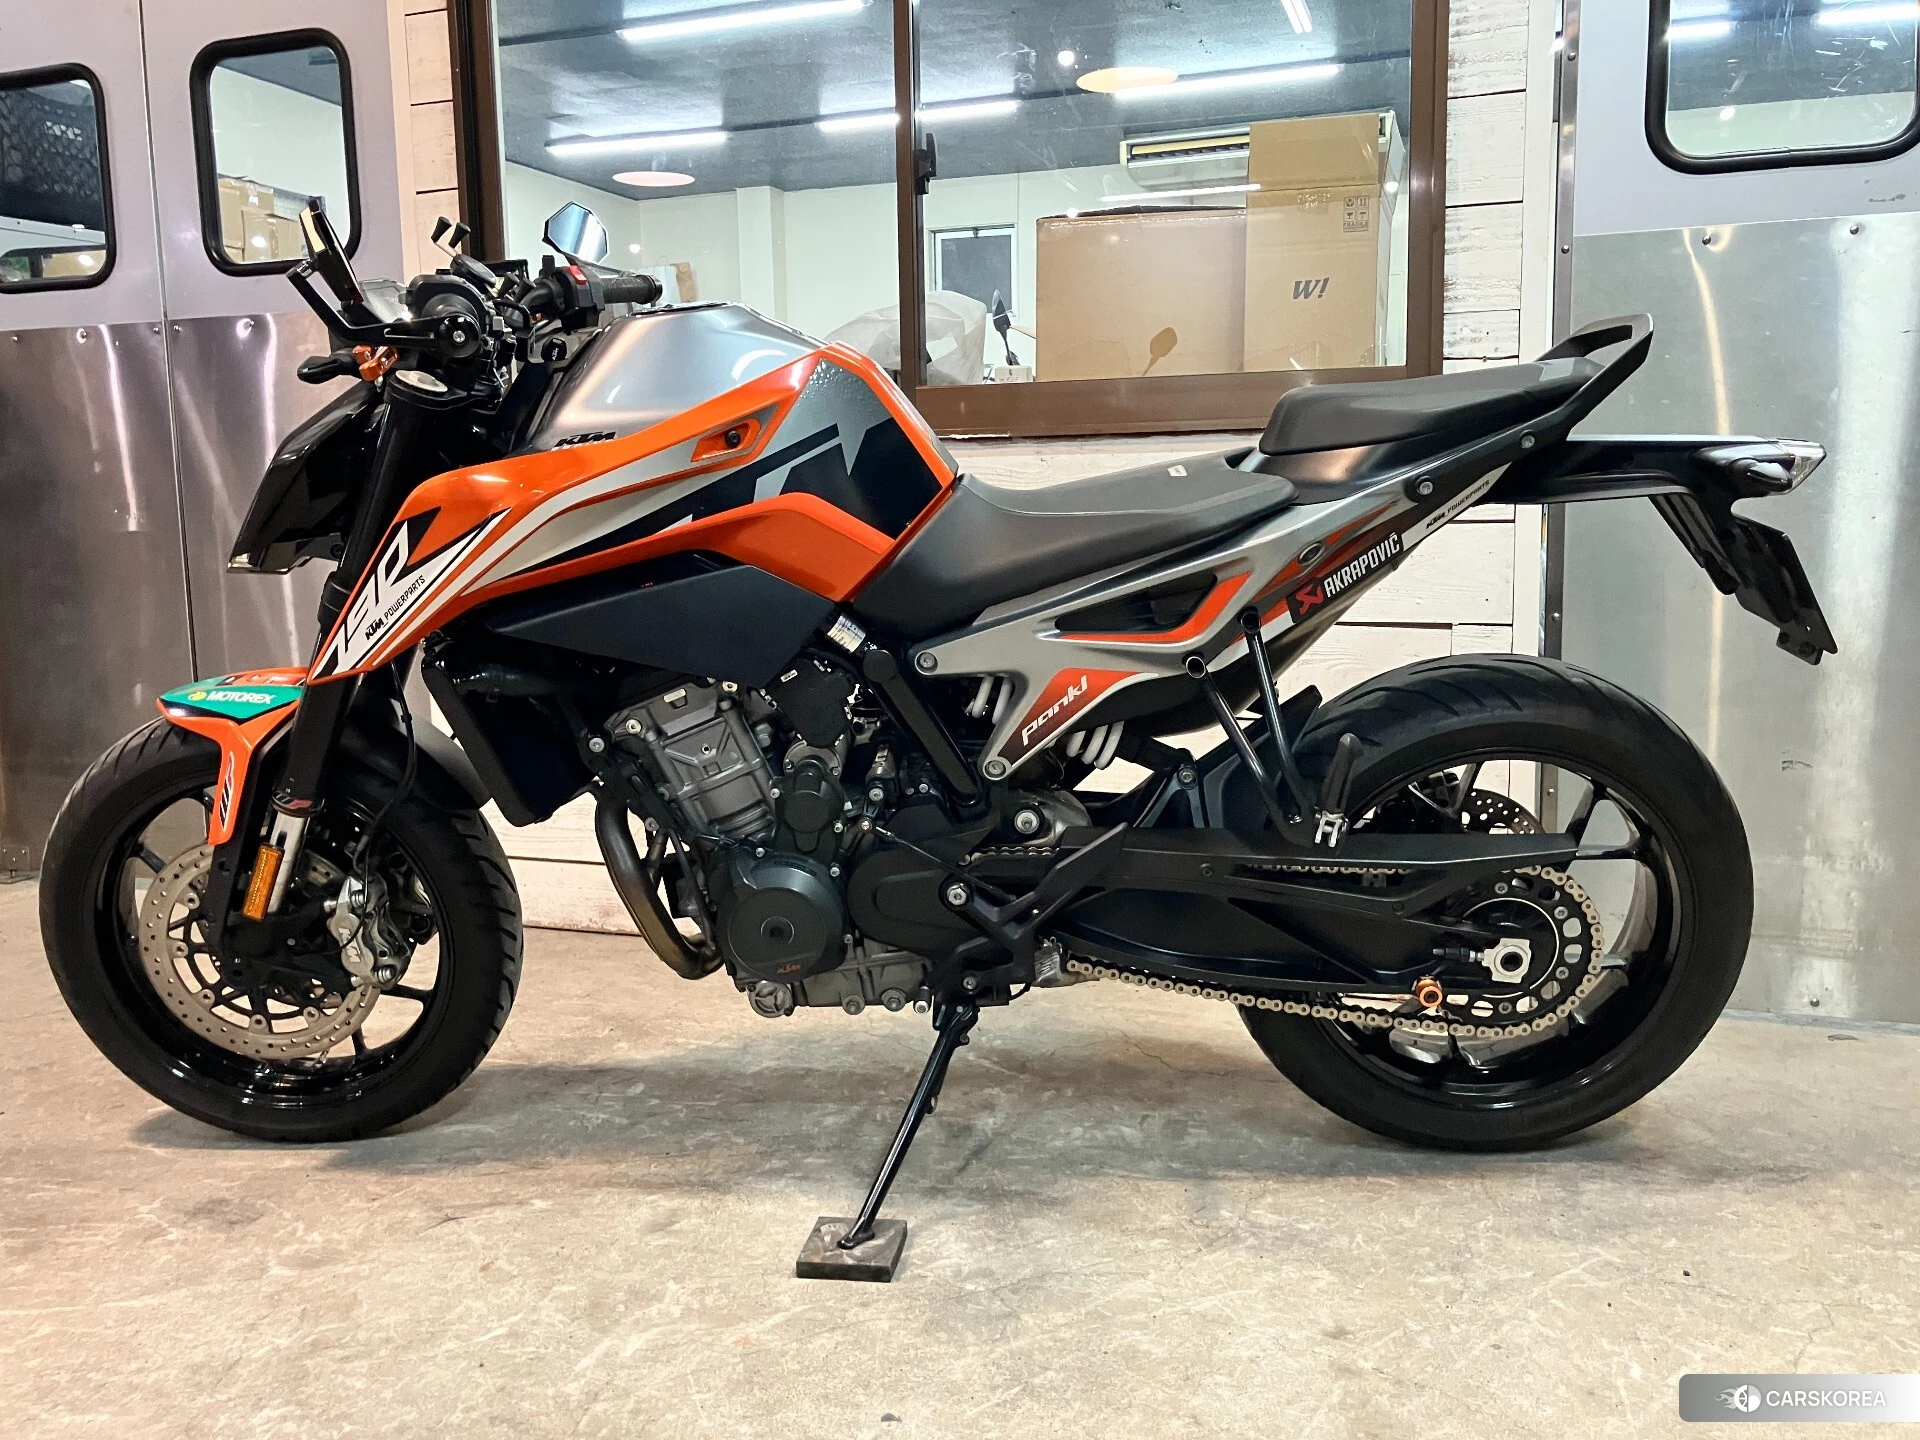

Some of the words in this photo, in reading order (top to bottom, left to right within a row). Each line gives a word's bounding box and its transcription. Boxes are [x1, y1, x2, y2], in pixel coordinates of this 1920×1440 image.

[1293, 277, 1330, 300] W!
[554, 431, 616, 448] KTM
[205, 690, 278, 705] MOTOREX
[1021, 674, 1088, 747] pankl
